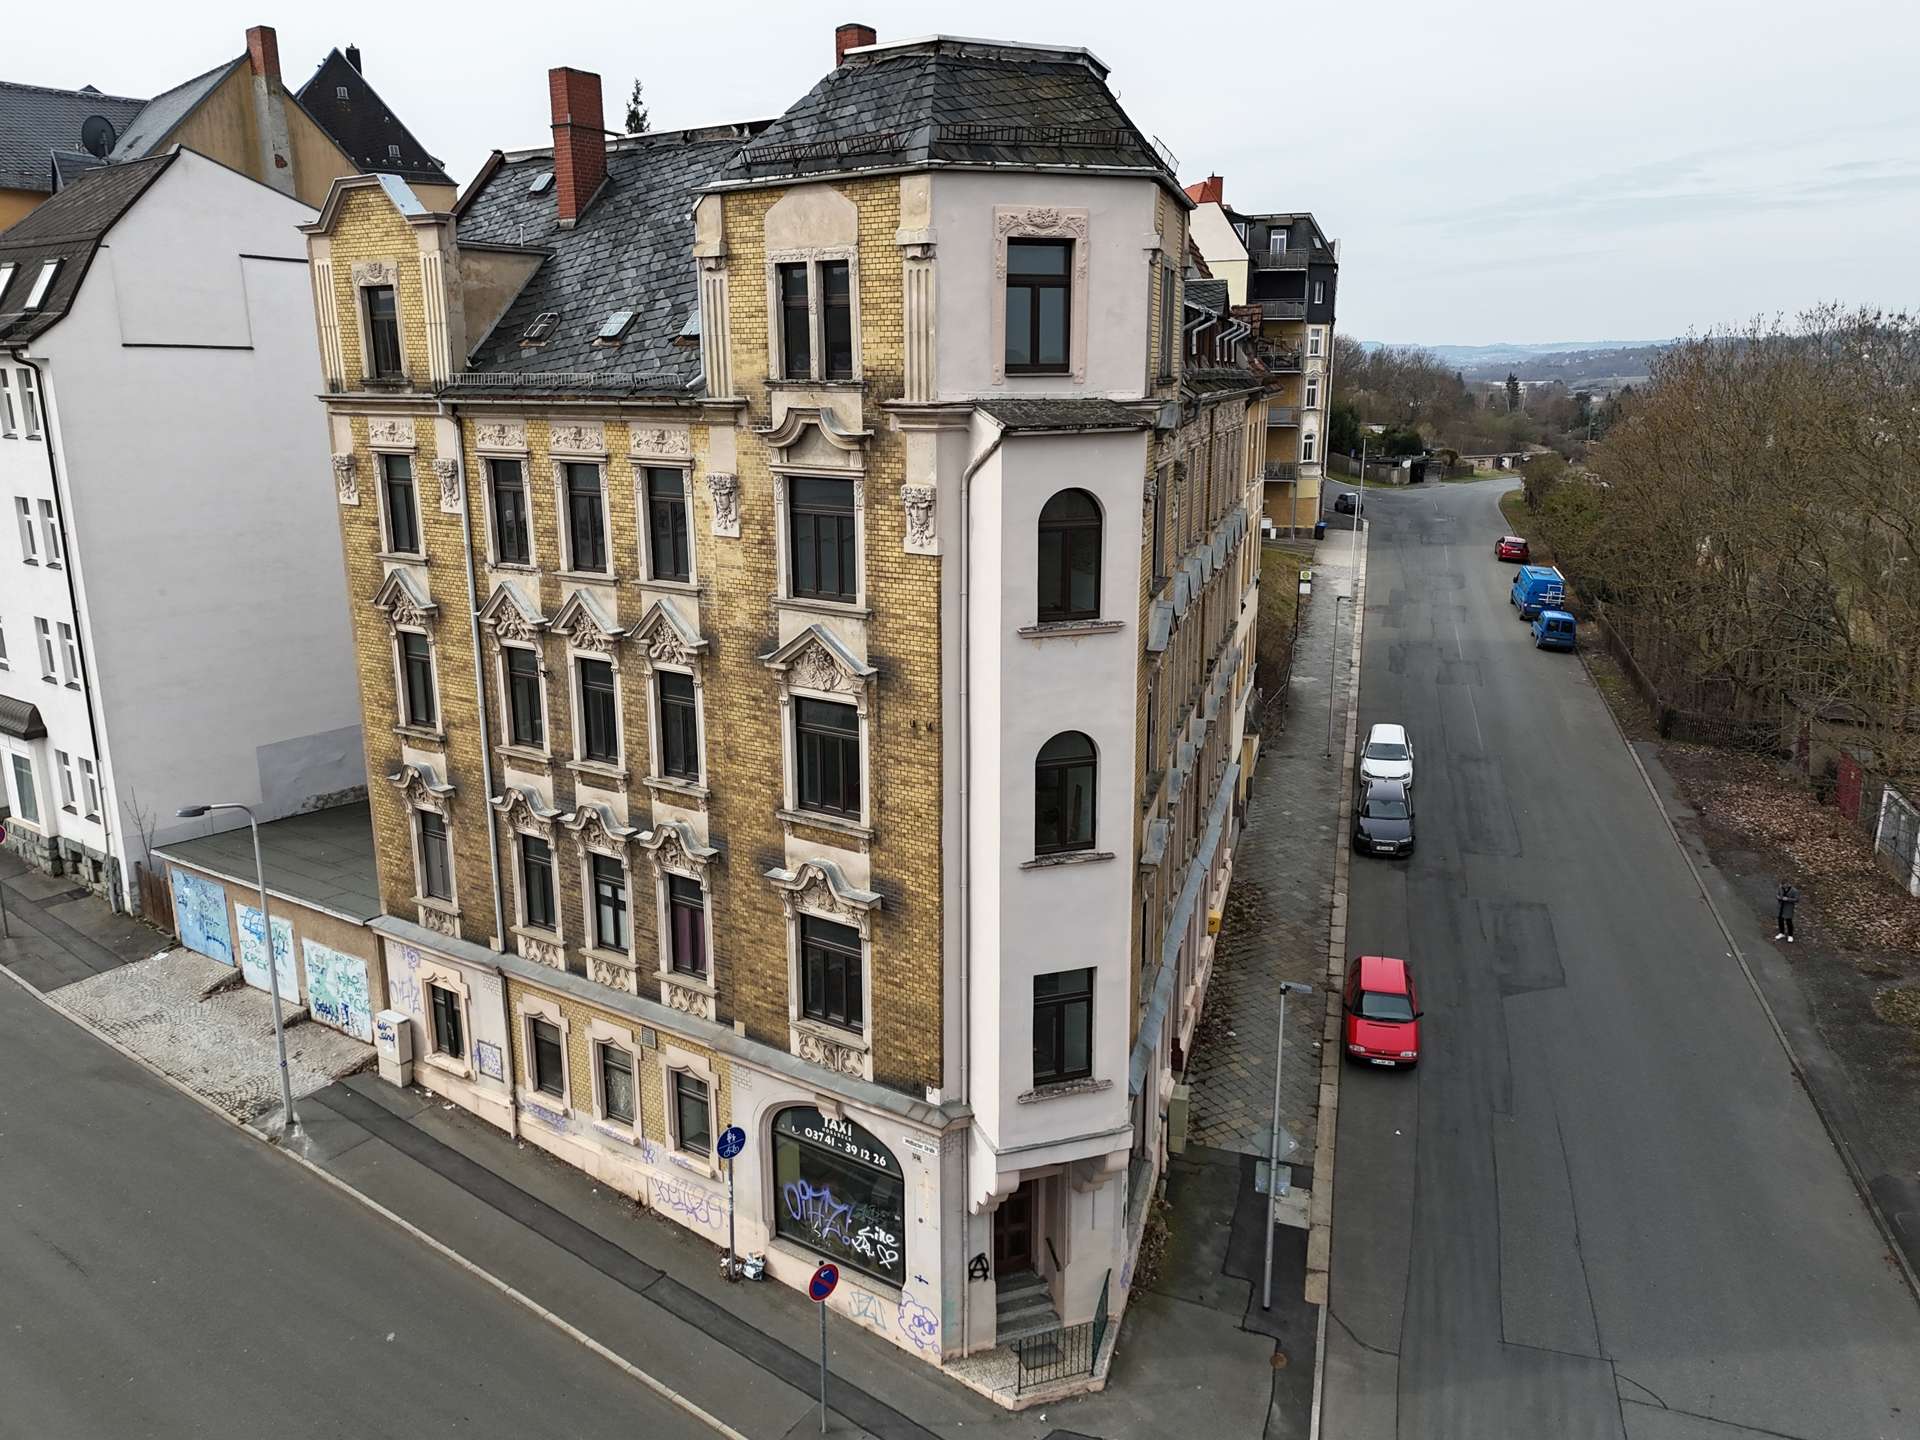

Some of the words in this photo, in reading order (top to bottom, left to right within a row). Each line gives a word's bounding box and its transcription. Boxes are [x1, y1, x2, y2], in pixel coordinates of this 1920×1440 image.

[822, 1114, 852, 1137] TAXI
[804, 1127, 835, 1147] 03741
[844, 1142, 858, 1155] 39
[860, 1148, 870, 1161] 12
[873, 1153, 887, 1167] 26
